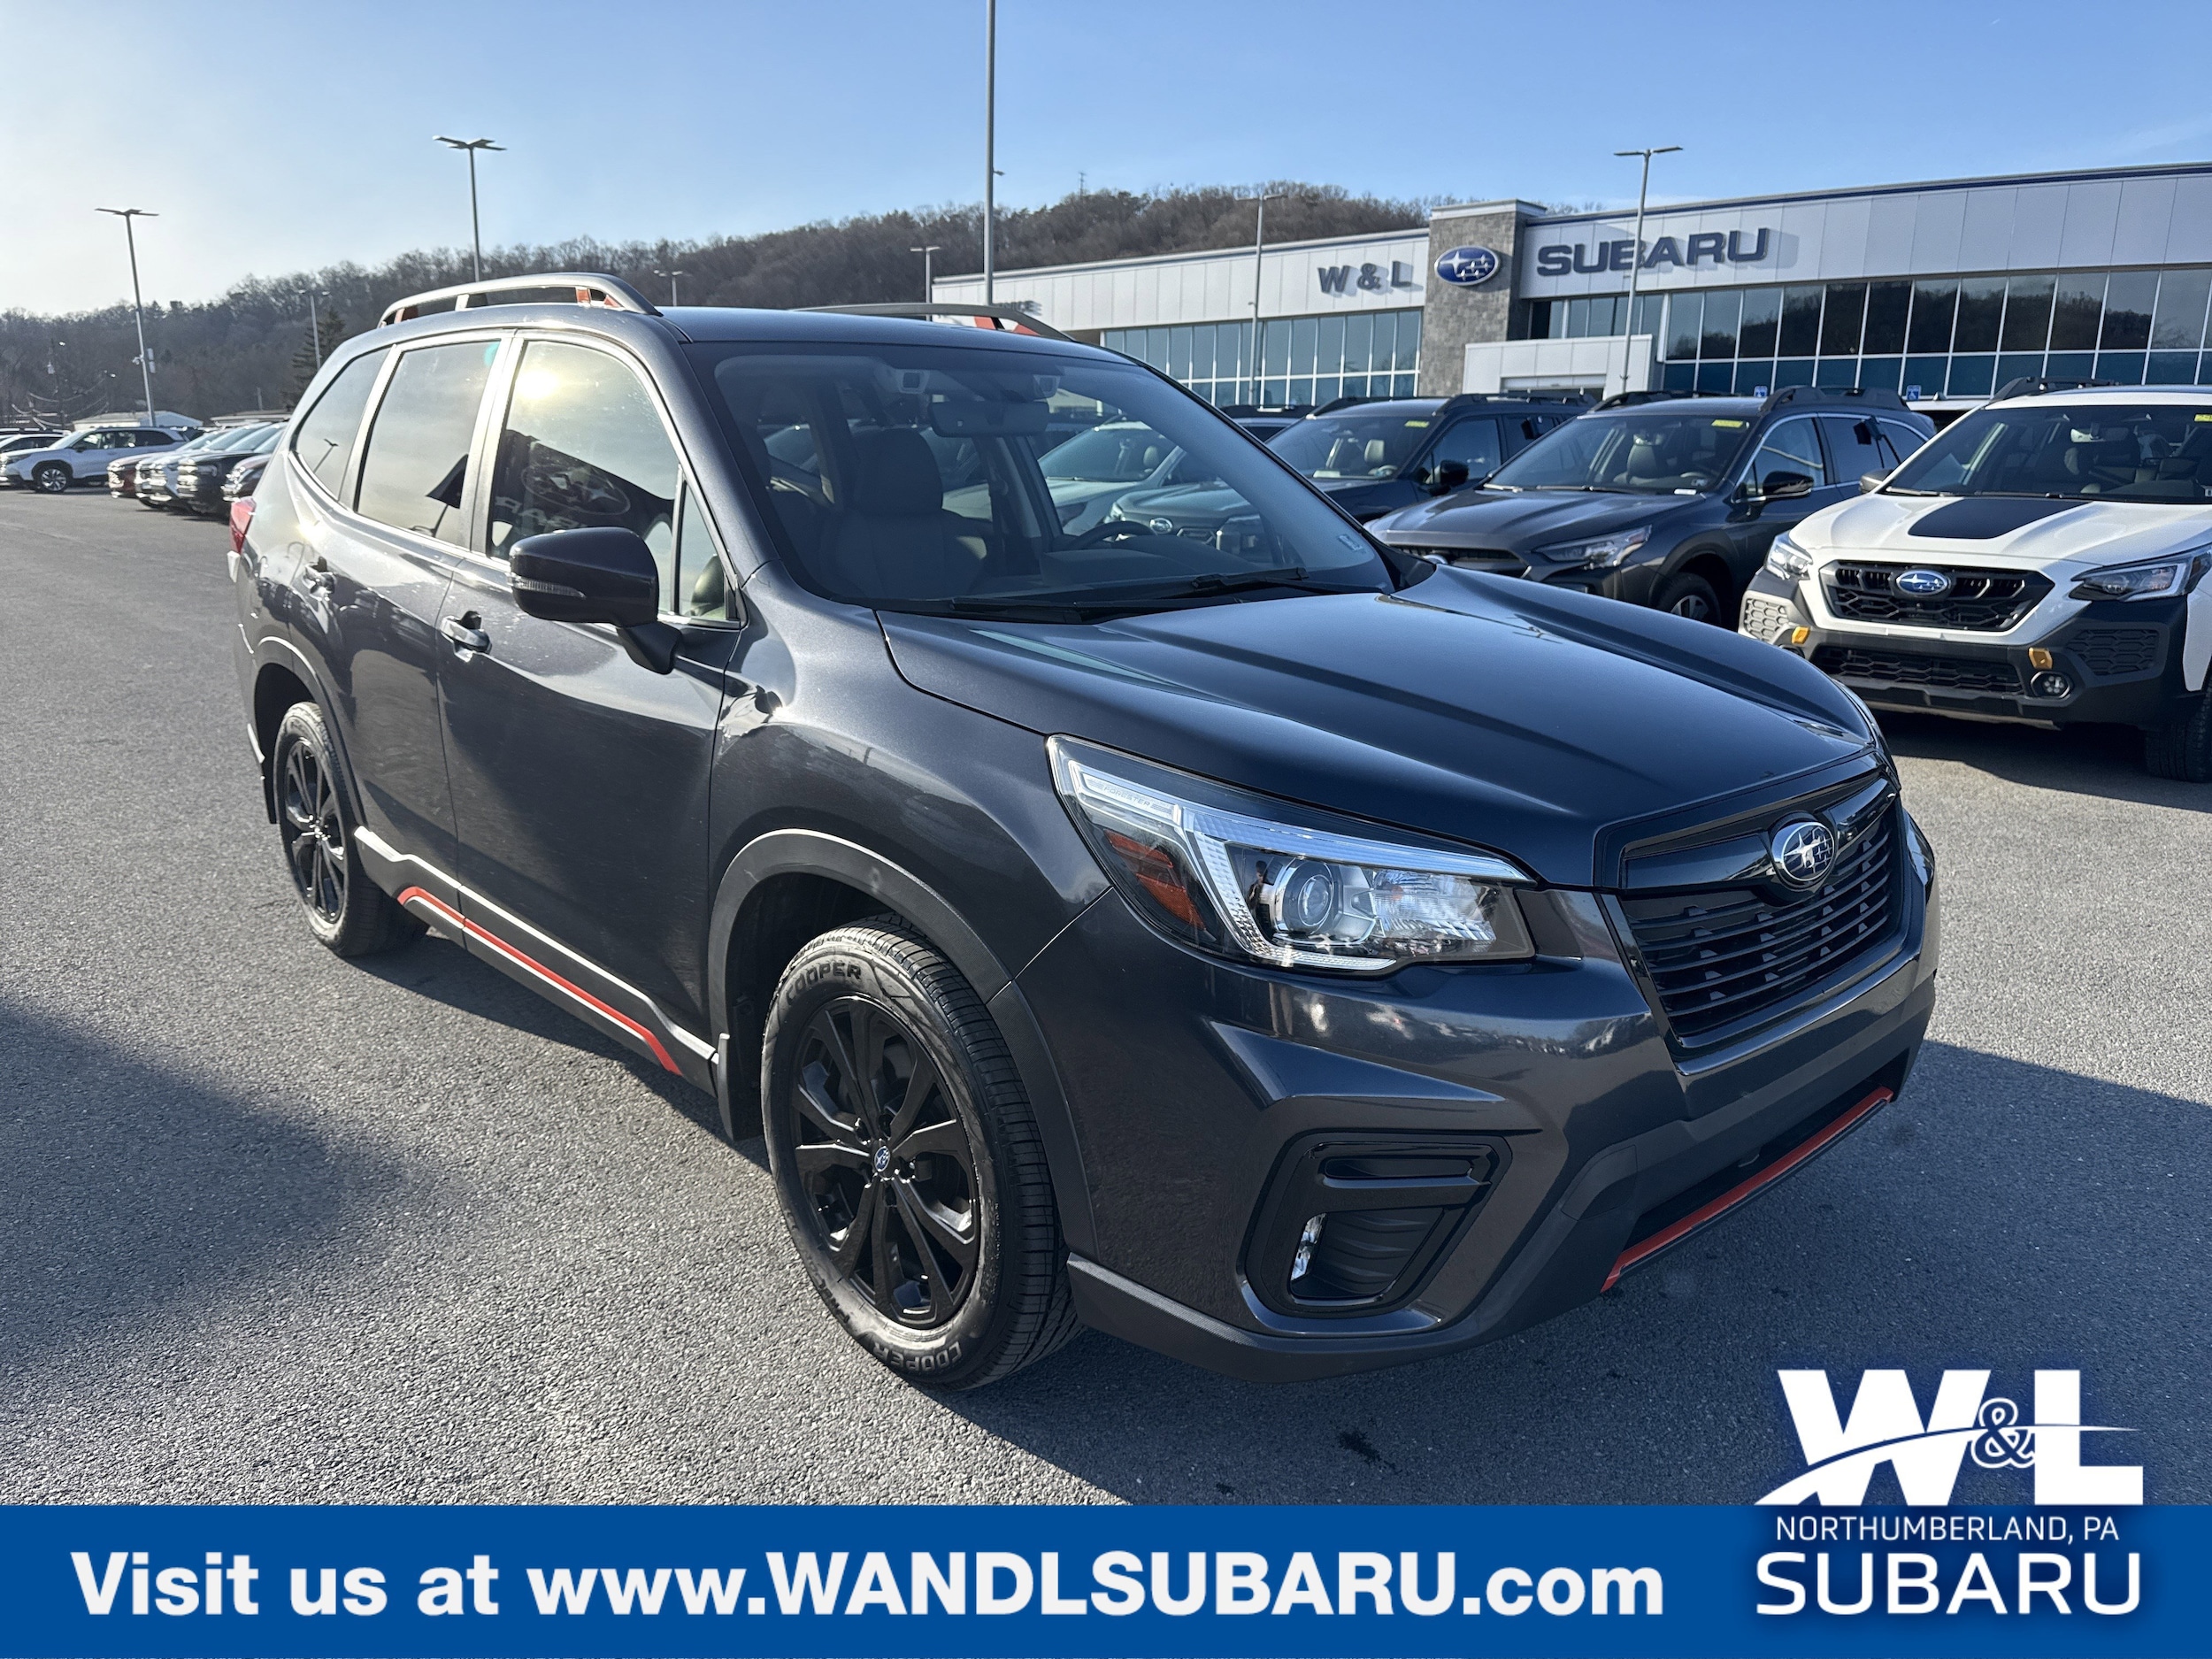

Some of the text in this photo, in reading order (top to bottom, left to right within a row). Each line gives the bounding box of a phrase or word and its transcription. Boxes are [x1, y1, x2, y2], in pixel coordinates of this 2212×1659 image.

[1536, 227, 1770, 277] SUBARU
[1317, 260, 1412, 294] W & L
[1103, 785, 1151, 806] FORESTER
[785, 961, 862, 1006] COOPER
[872, 1340, 963, 1371] COOPER
